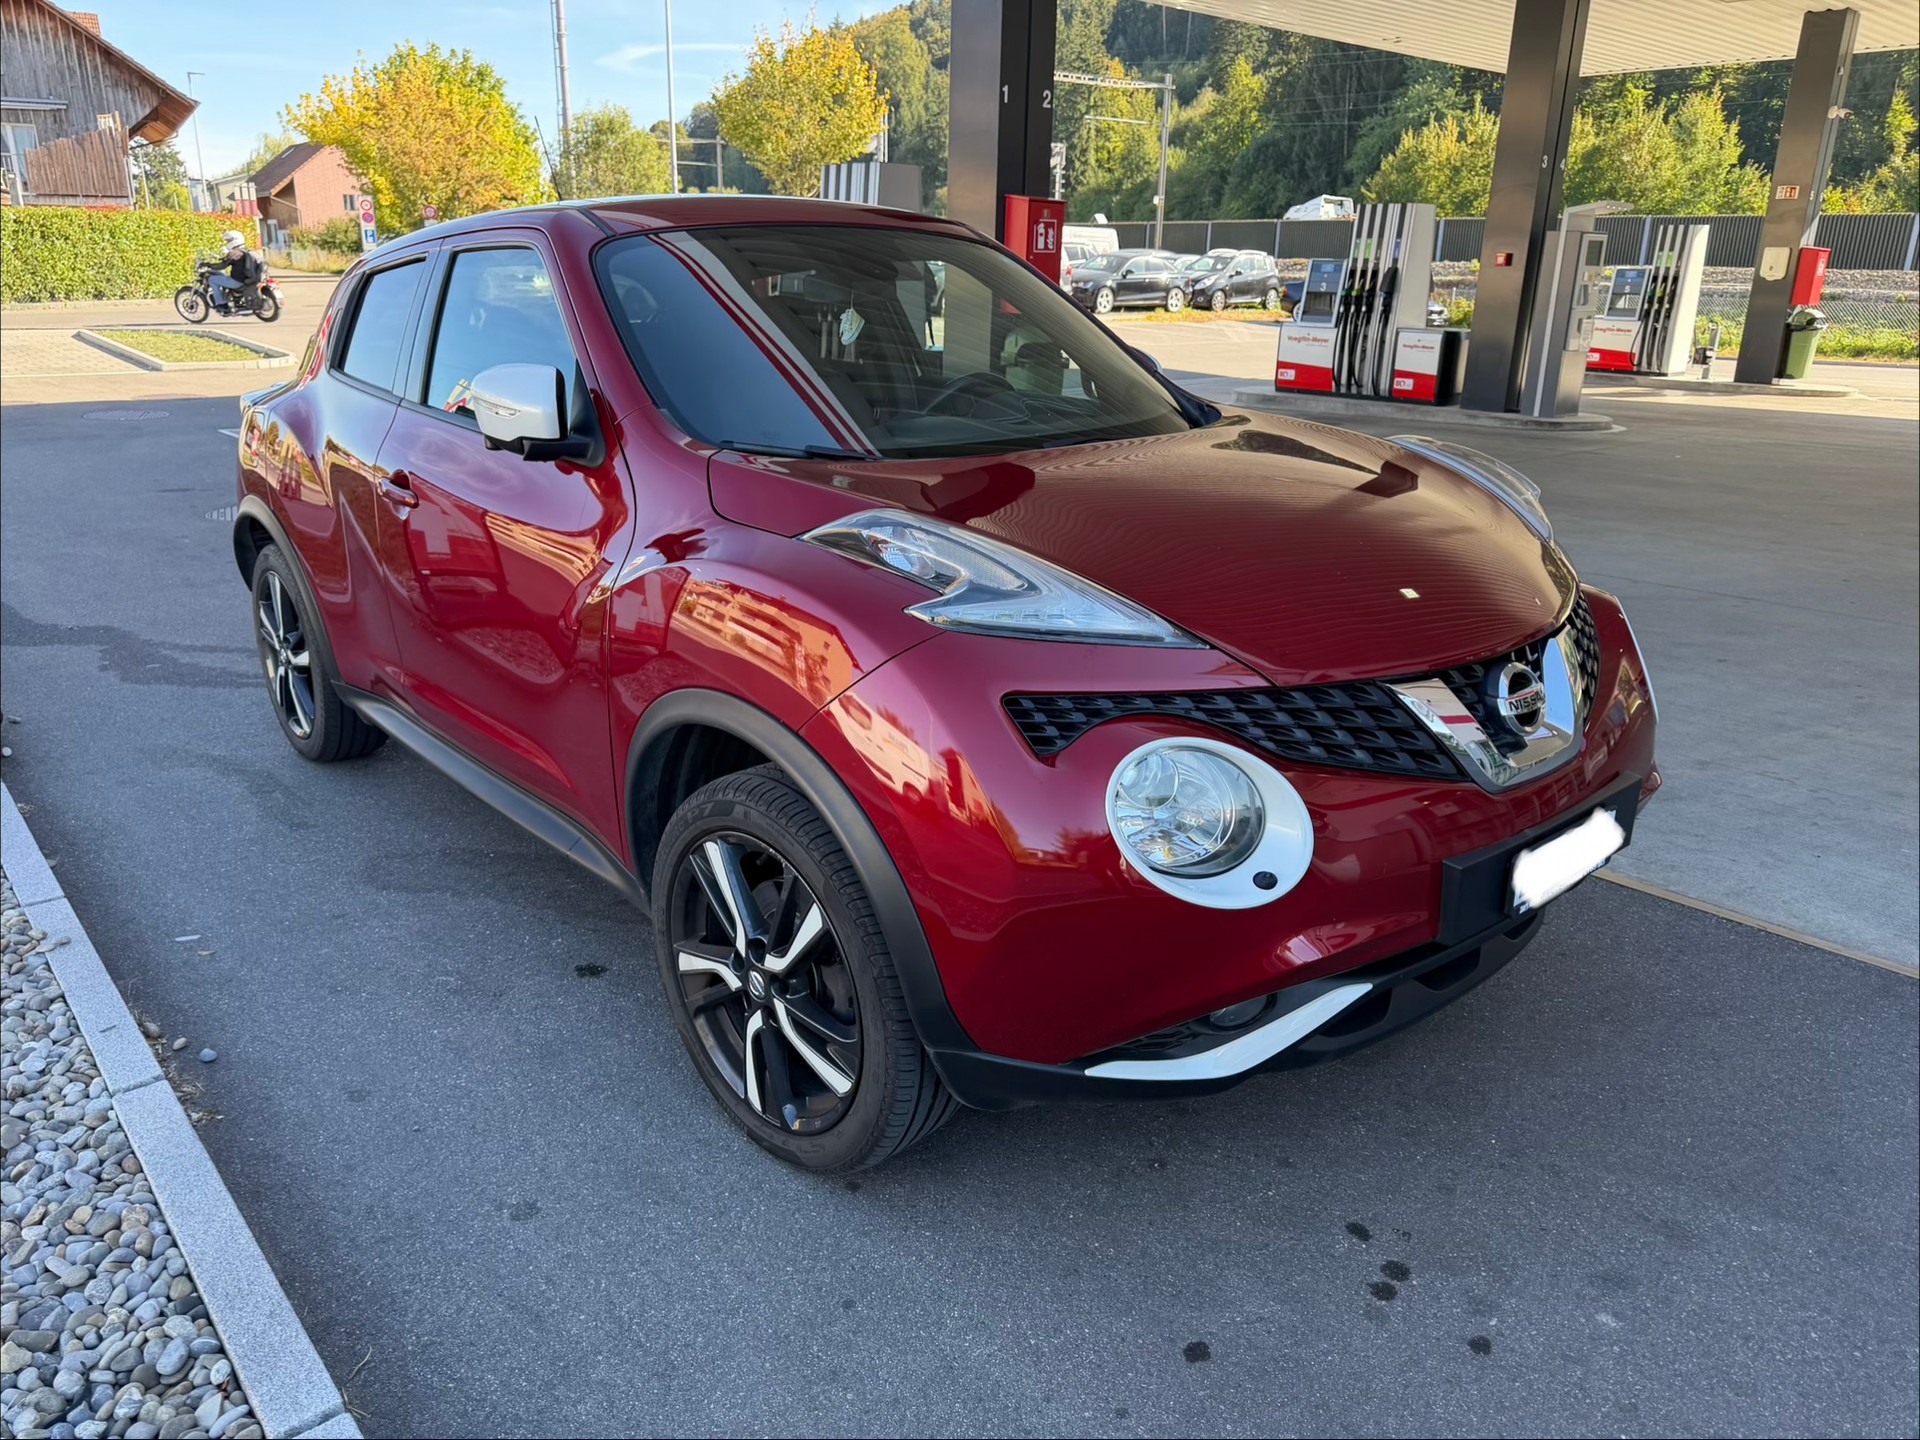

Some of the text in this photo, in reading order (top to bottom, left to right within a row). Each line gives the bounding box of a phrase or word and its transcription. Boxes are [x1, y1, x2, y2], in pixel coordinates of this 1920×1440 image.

[1002, 84, 1009, 104] 1
[1042, 90, 1052, 109] 2
[1541, 155, 1548, 168] 3
[1560, 158, 1566, 171] 4
[1320, 282, 1327, 292] 3
[1624, 285, 1631, 293] 5
